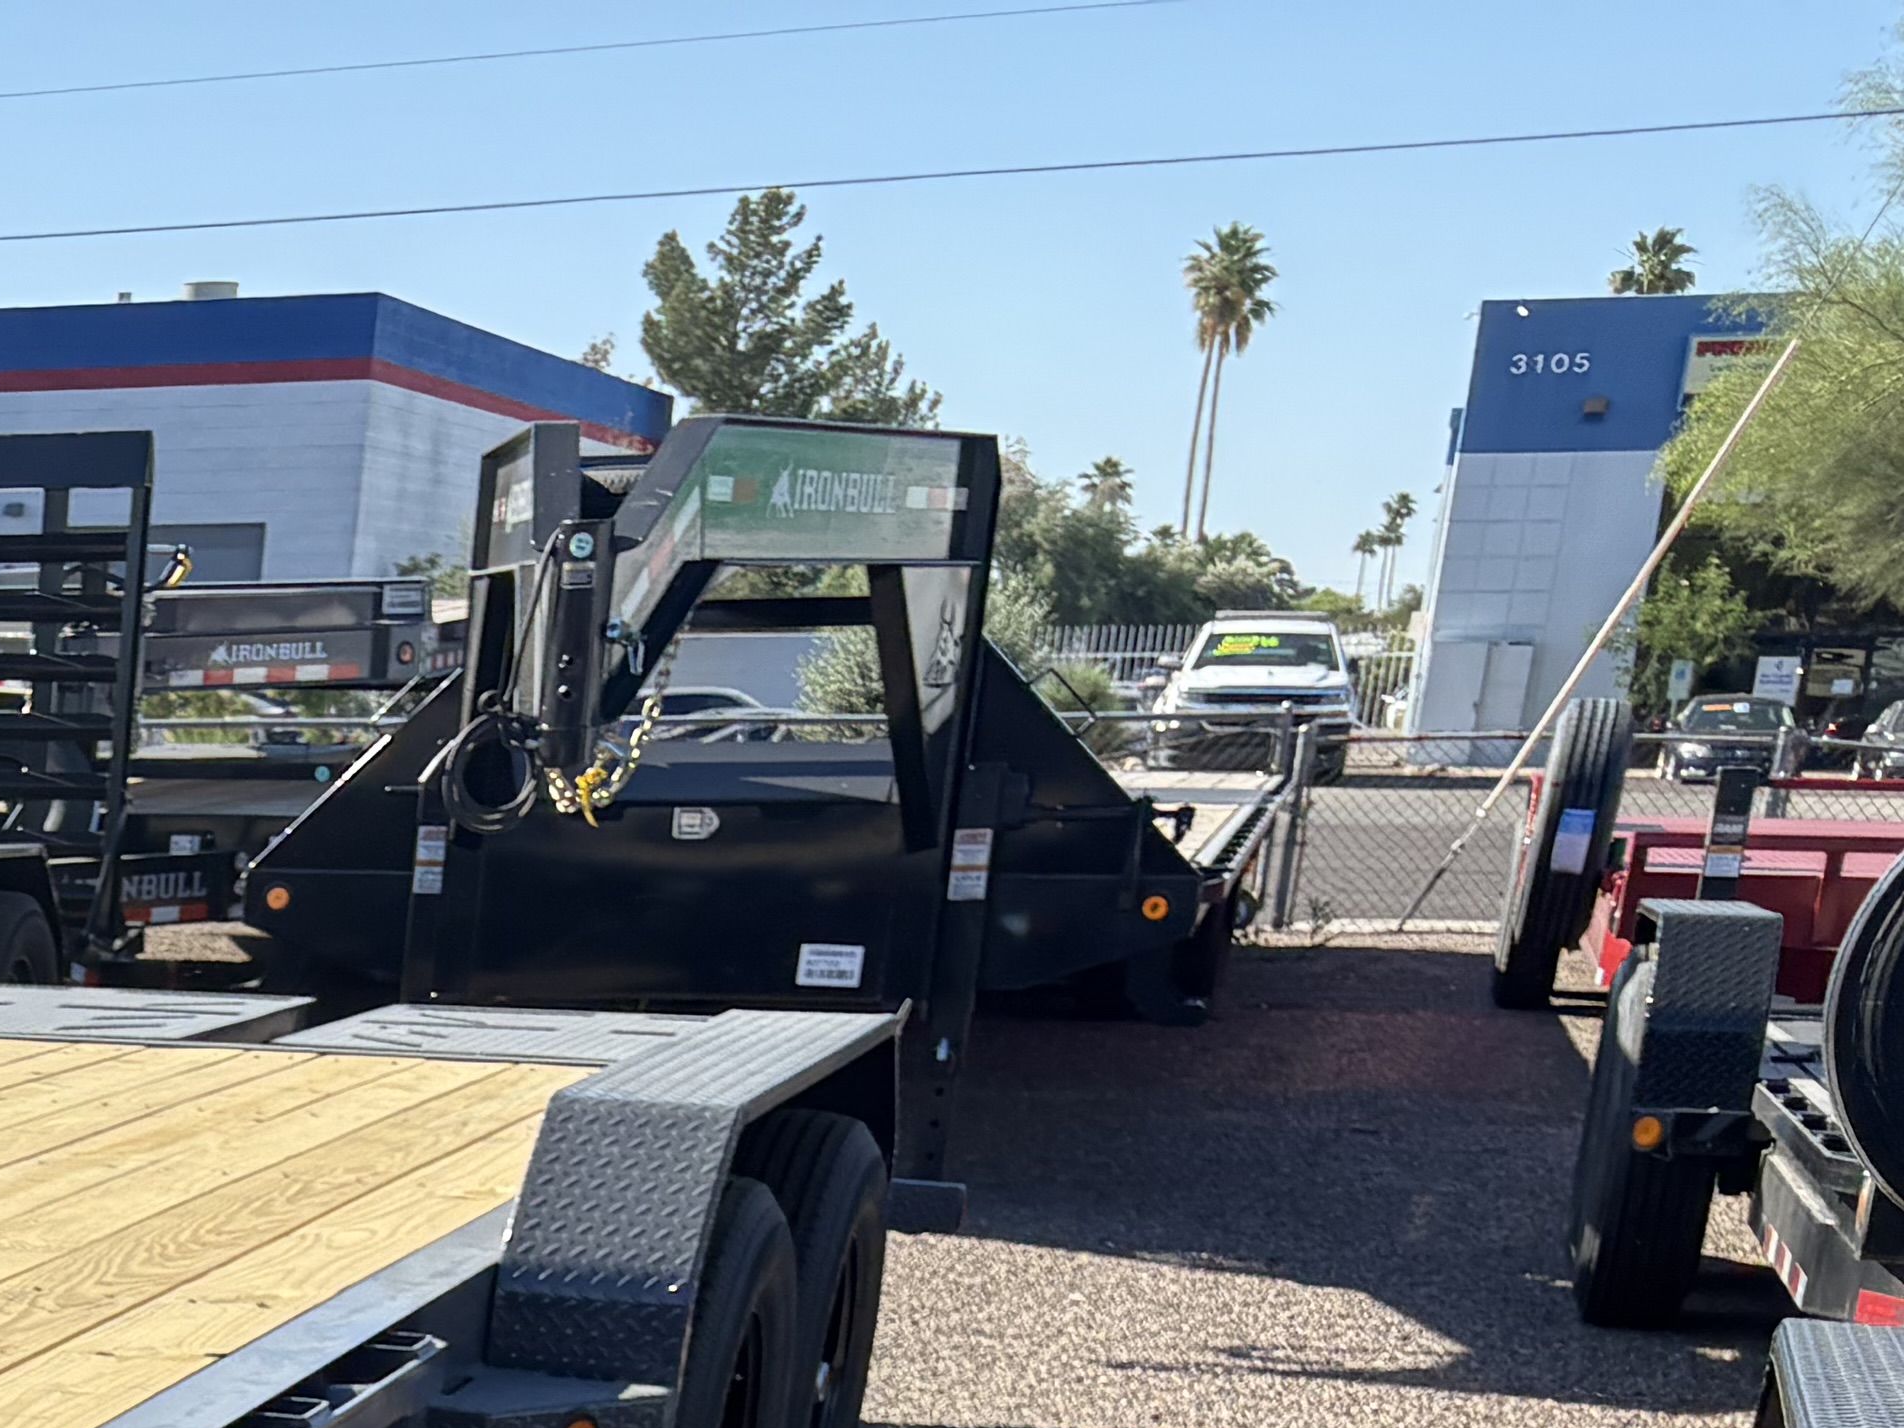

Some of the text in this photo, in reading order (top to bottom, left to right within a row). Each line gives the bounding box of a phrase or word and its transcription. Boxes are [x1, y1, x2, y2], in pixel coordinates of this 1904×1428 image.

[1509, 352, 1591, 375] 3105
[793, 469, 897, 514] IRONBULL
[232, 641, 328, 662] IRONBULL
[120, 871, 208, 900] NBULL
